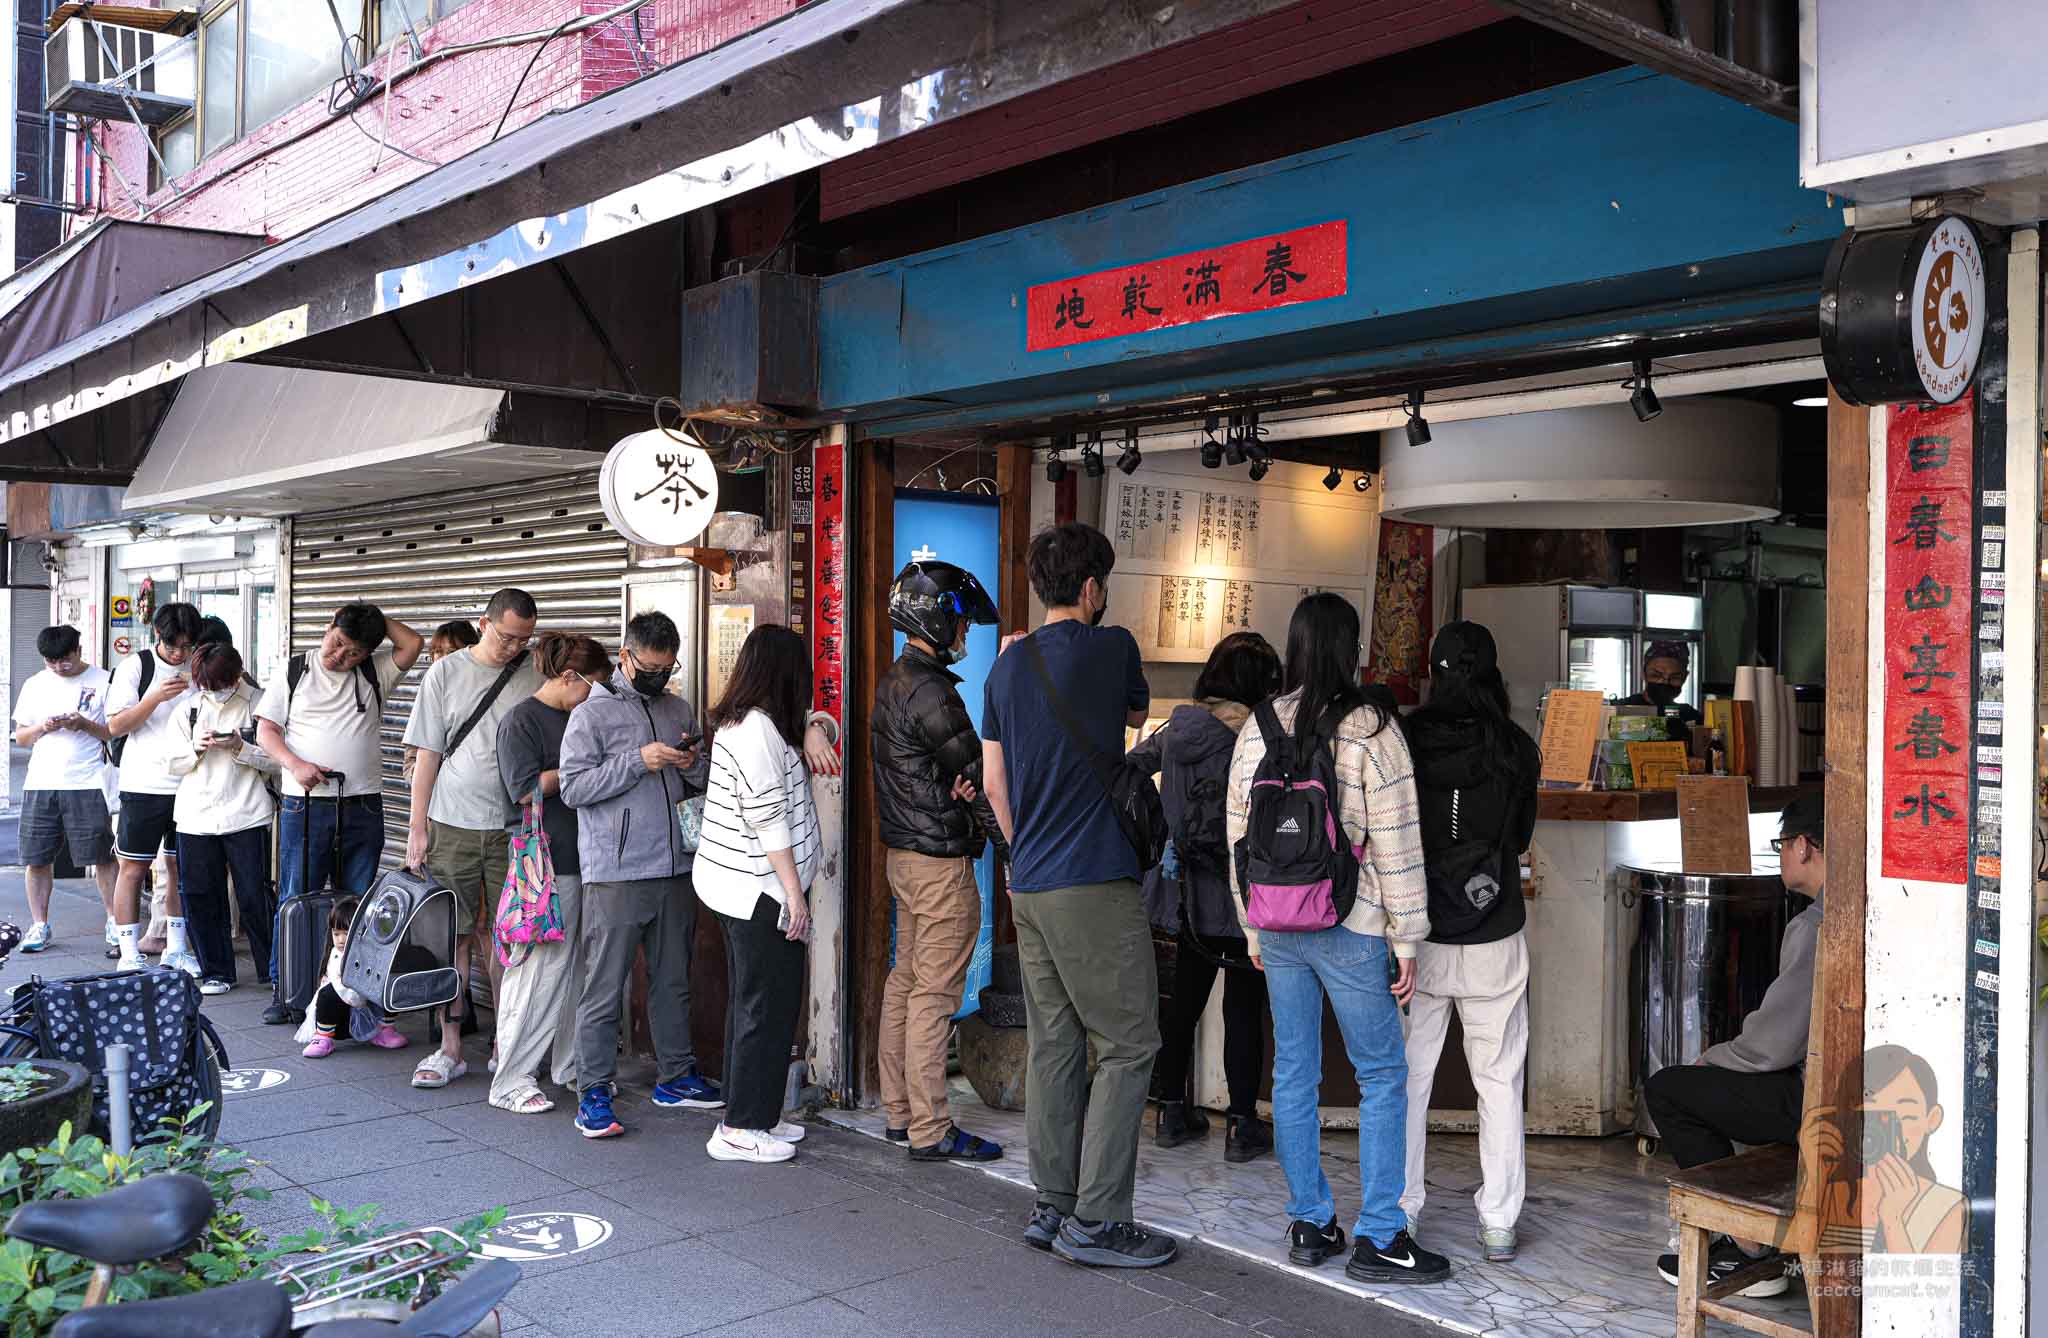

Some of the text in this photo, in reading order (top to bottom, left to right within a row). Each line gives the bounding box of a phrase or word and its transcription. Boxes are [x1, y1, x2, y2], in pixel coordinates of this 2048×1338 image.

[1916, 349, 1959, 394] Handmade
[633, 453, 710, 515] 茶
[1193, 578, 1207, 622] 珍珠奶茶
[1892, 403, 1961, 827] 日春山享春水
